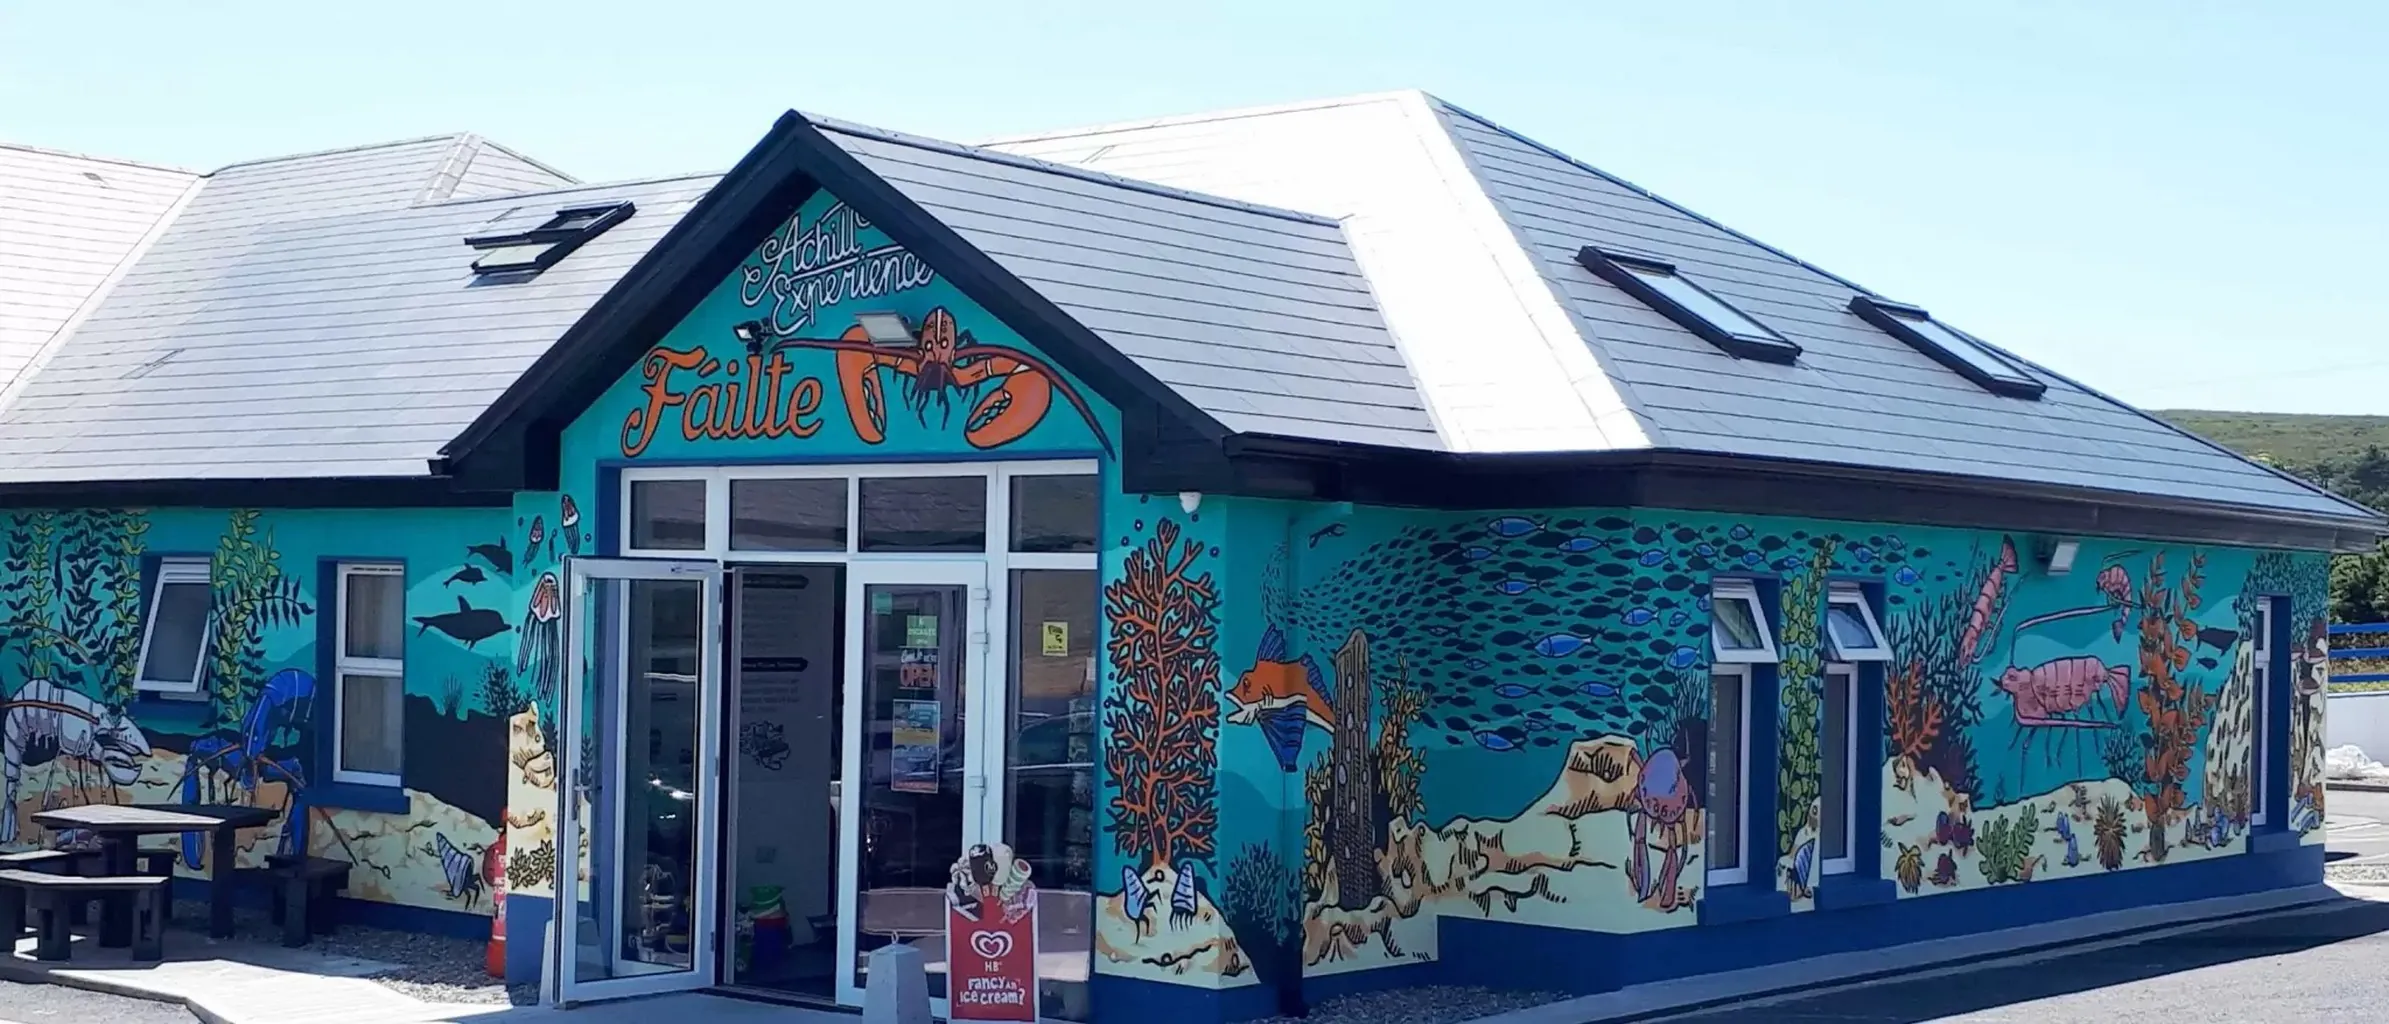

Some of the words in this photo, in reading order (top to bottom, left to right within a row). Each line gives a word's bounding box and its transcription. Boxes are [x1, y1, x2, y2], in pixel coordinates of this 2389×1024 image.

[741, 201, 871, 307] Achill
[771, 246, 936, 336] Experience
[620, 345, 824, 457] Fáilte
